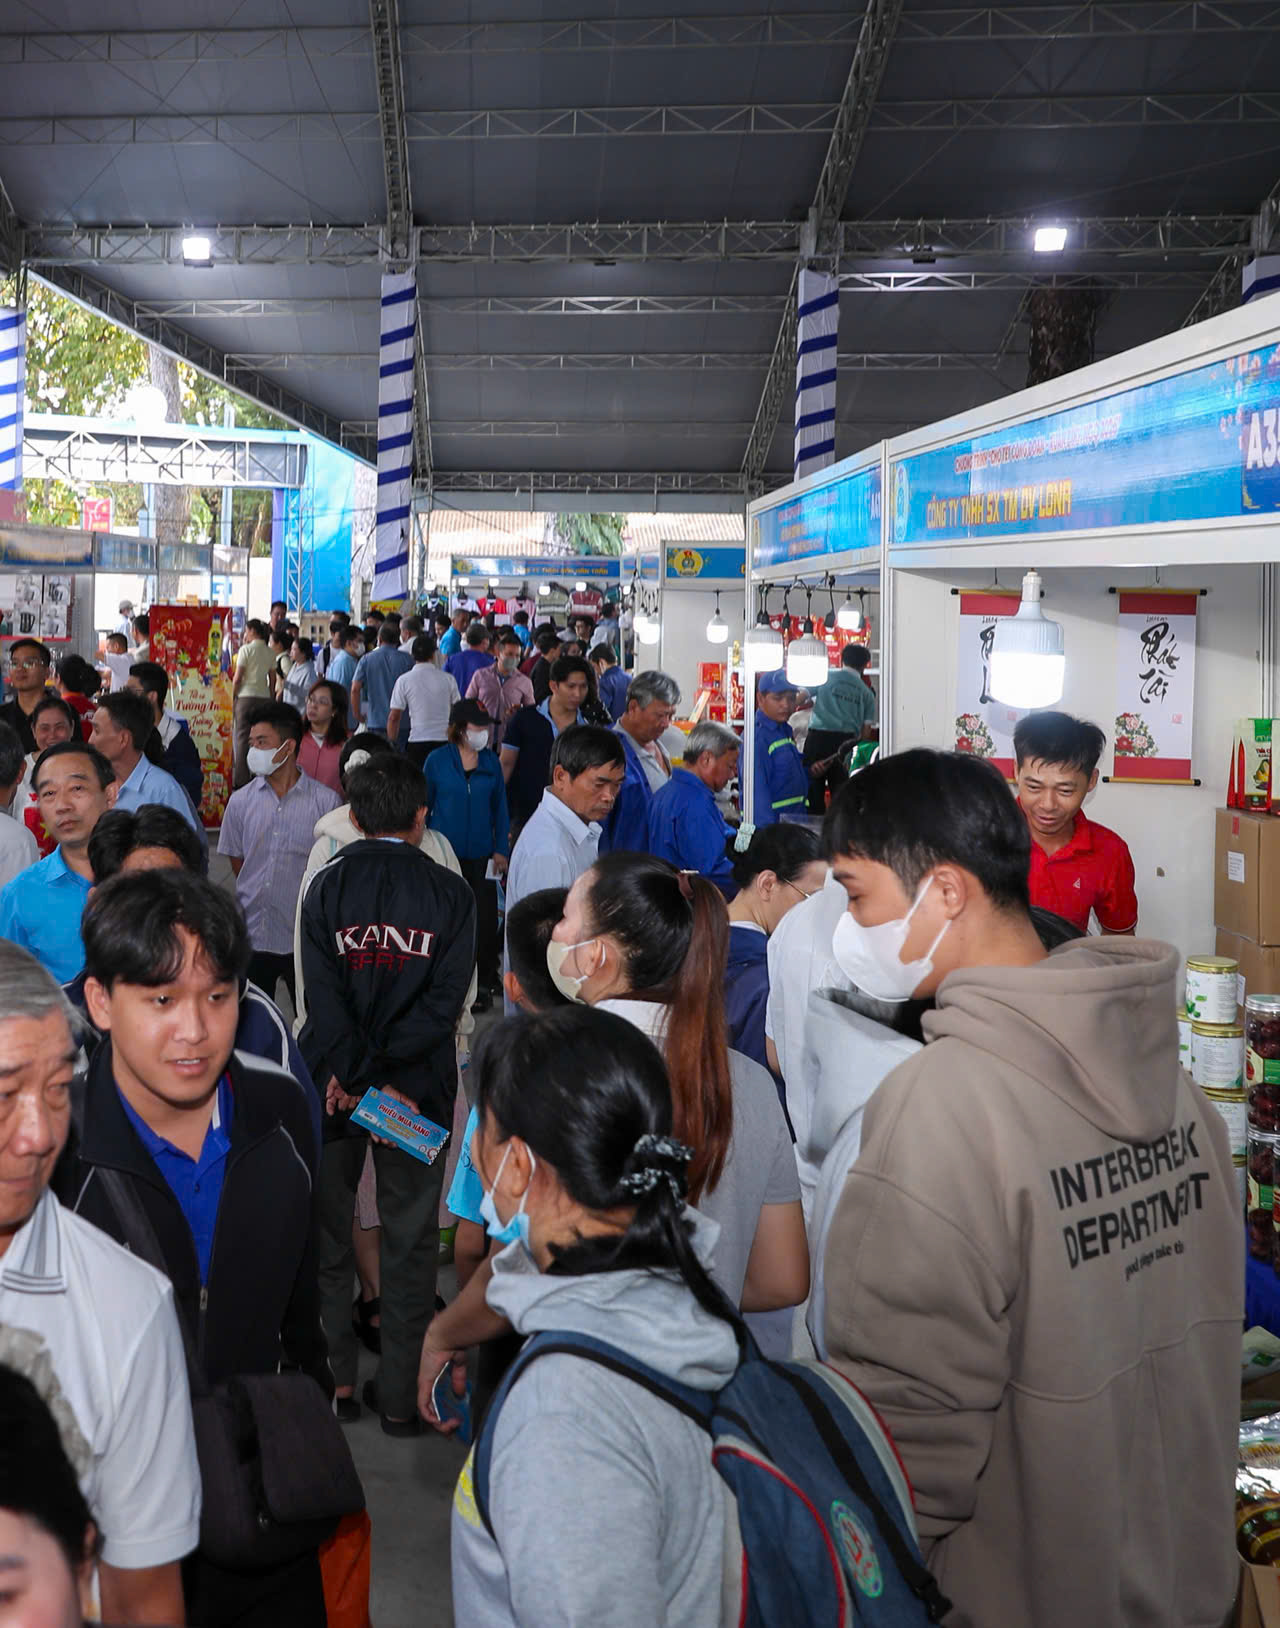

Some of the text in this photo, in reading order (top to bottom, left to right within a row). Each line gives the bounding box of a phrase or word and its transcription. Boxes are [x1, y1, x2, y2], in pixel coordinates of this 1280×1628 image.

[1246, 408, 1280, 469] A3
[927, 495, 946, 529] CÔNG
[949, 498, 959, 527] TY
[961, 494, 984, 527] TNHH
[986, 491, 1001, 524] SX
[1003, 487, 1018, 522] TM
[335, 925, 434, 957] KANI
